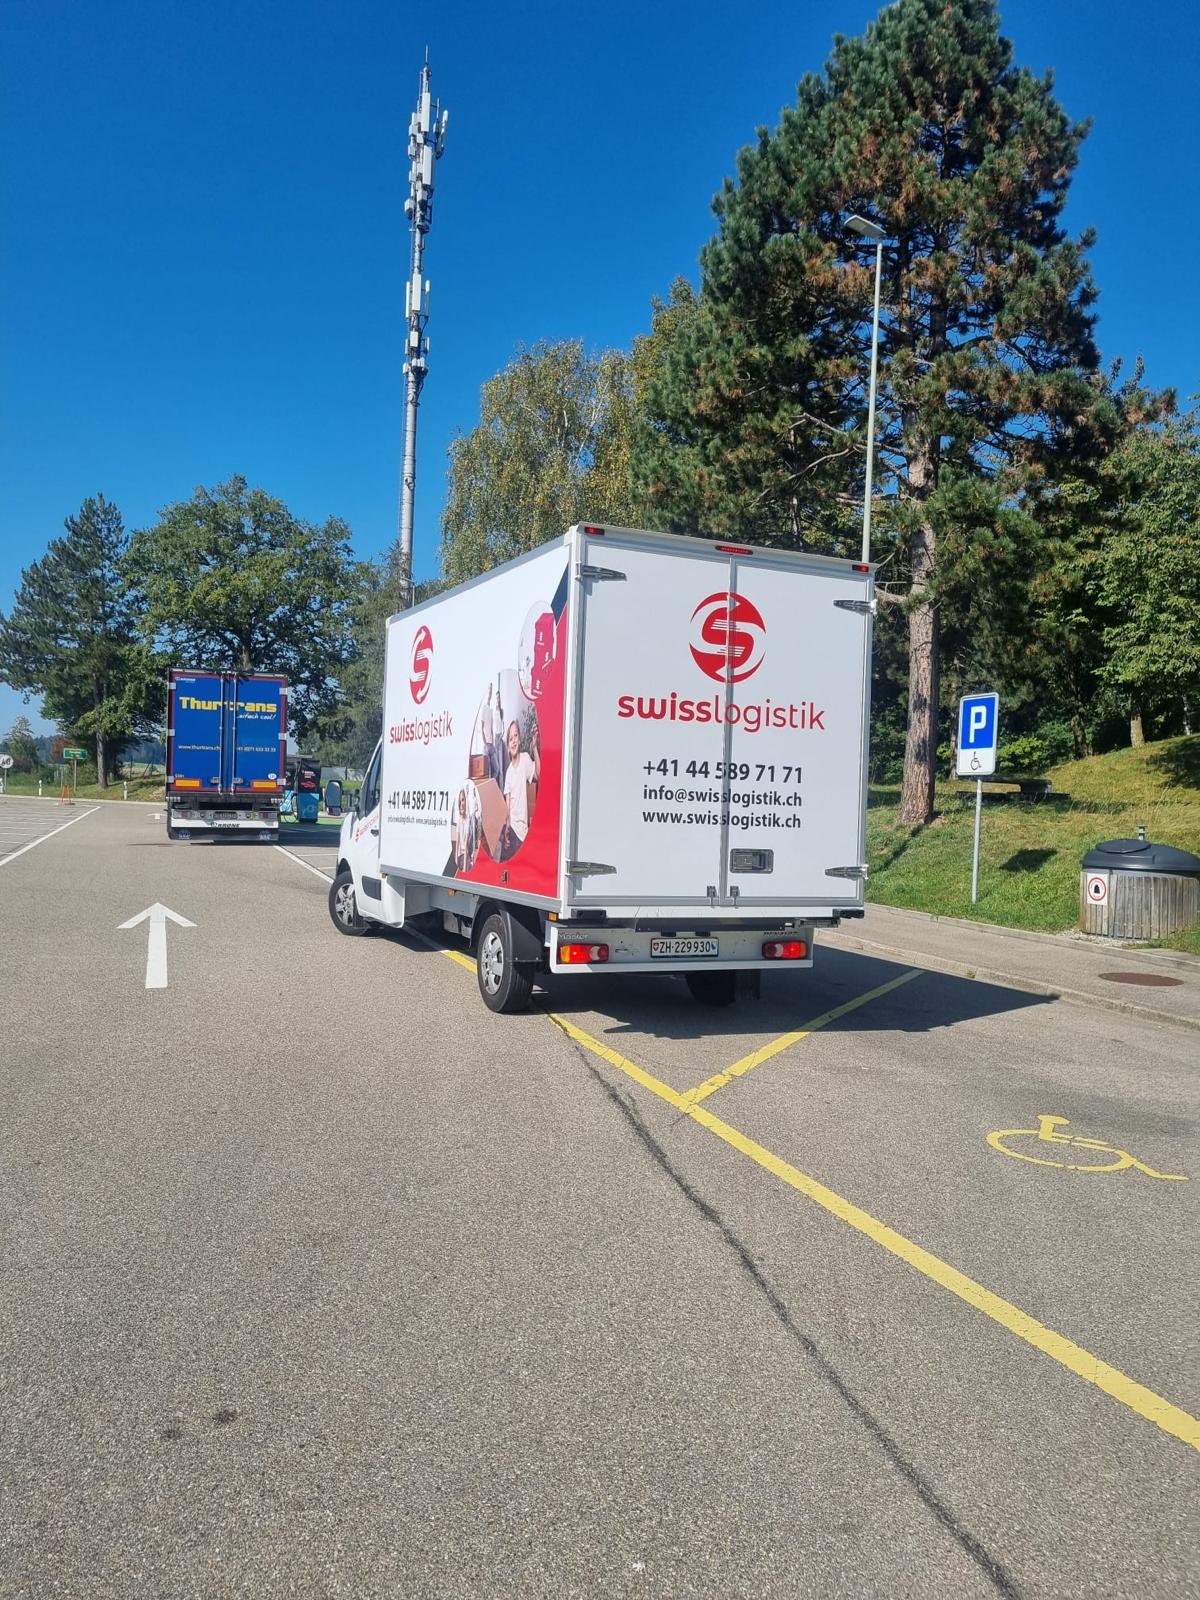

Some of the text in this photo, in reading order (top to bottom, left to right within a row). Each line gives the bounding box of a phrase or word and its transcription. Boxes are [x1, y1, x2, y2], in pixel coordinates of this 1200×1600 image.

[618, 692, 825, 733] swisslogistik
[969, 705, 987, 743] P
[389, 711, 453, 745] swisslogistik
[643, 758, 803, 784] +41 44 589 71 71
[388, 790, 449, 811] +41 44 589 71 71
[643, 784, 803, 808] info@swisslogistik.ch
[643, 810, 802, 830] www.swisslogistik.ch
